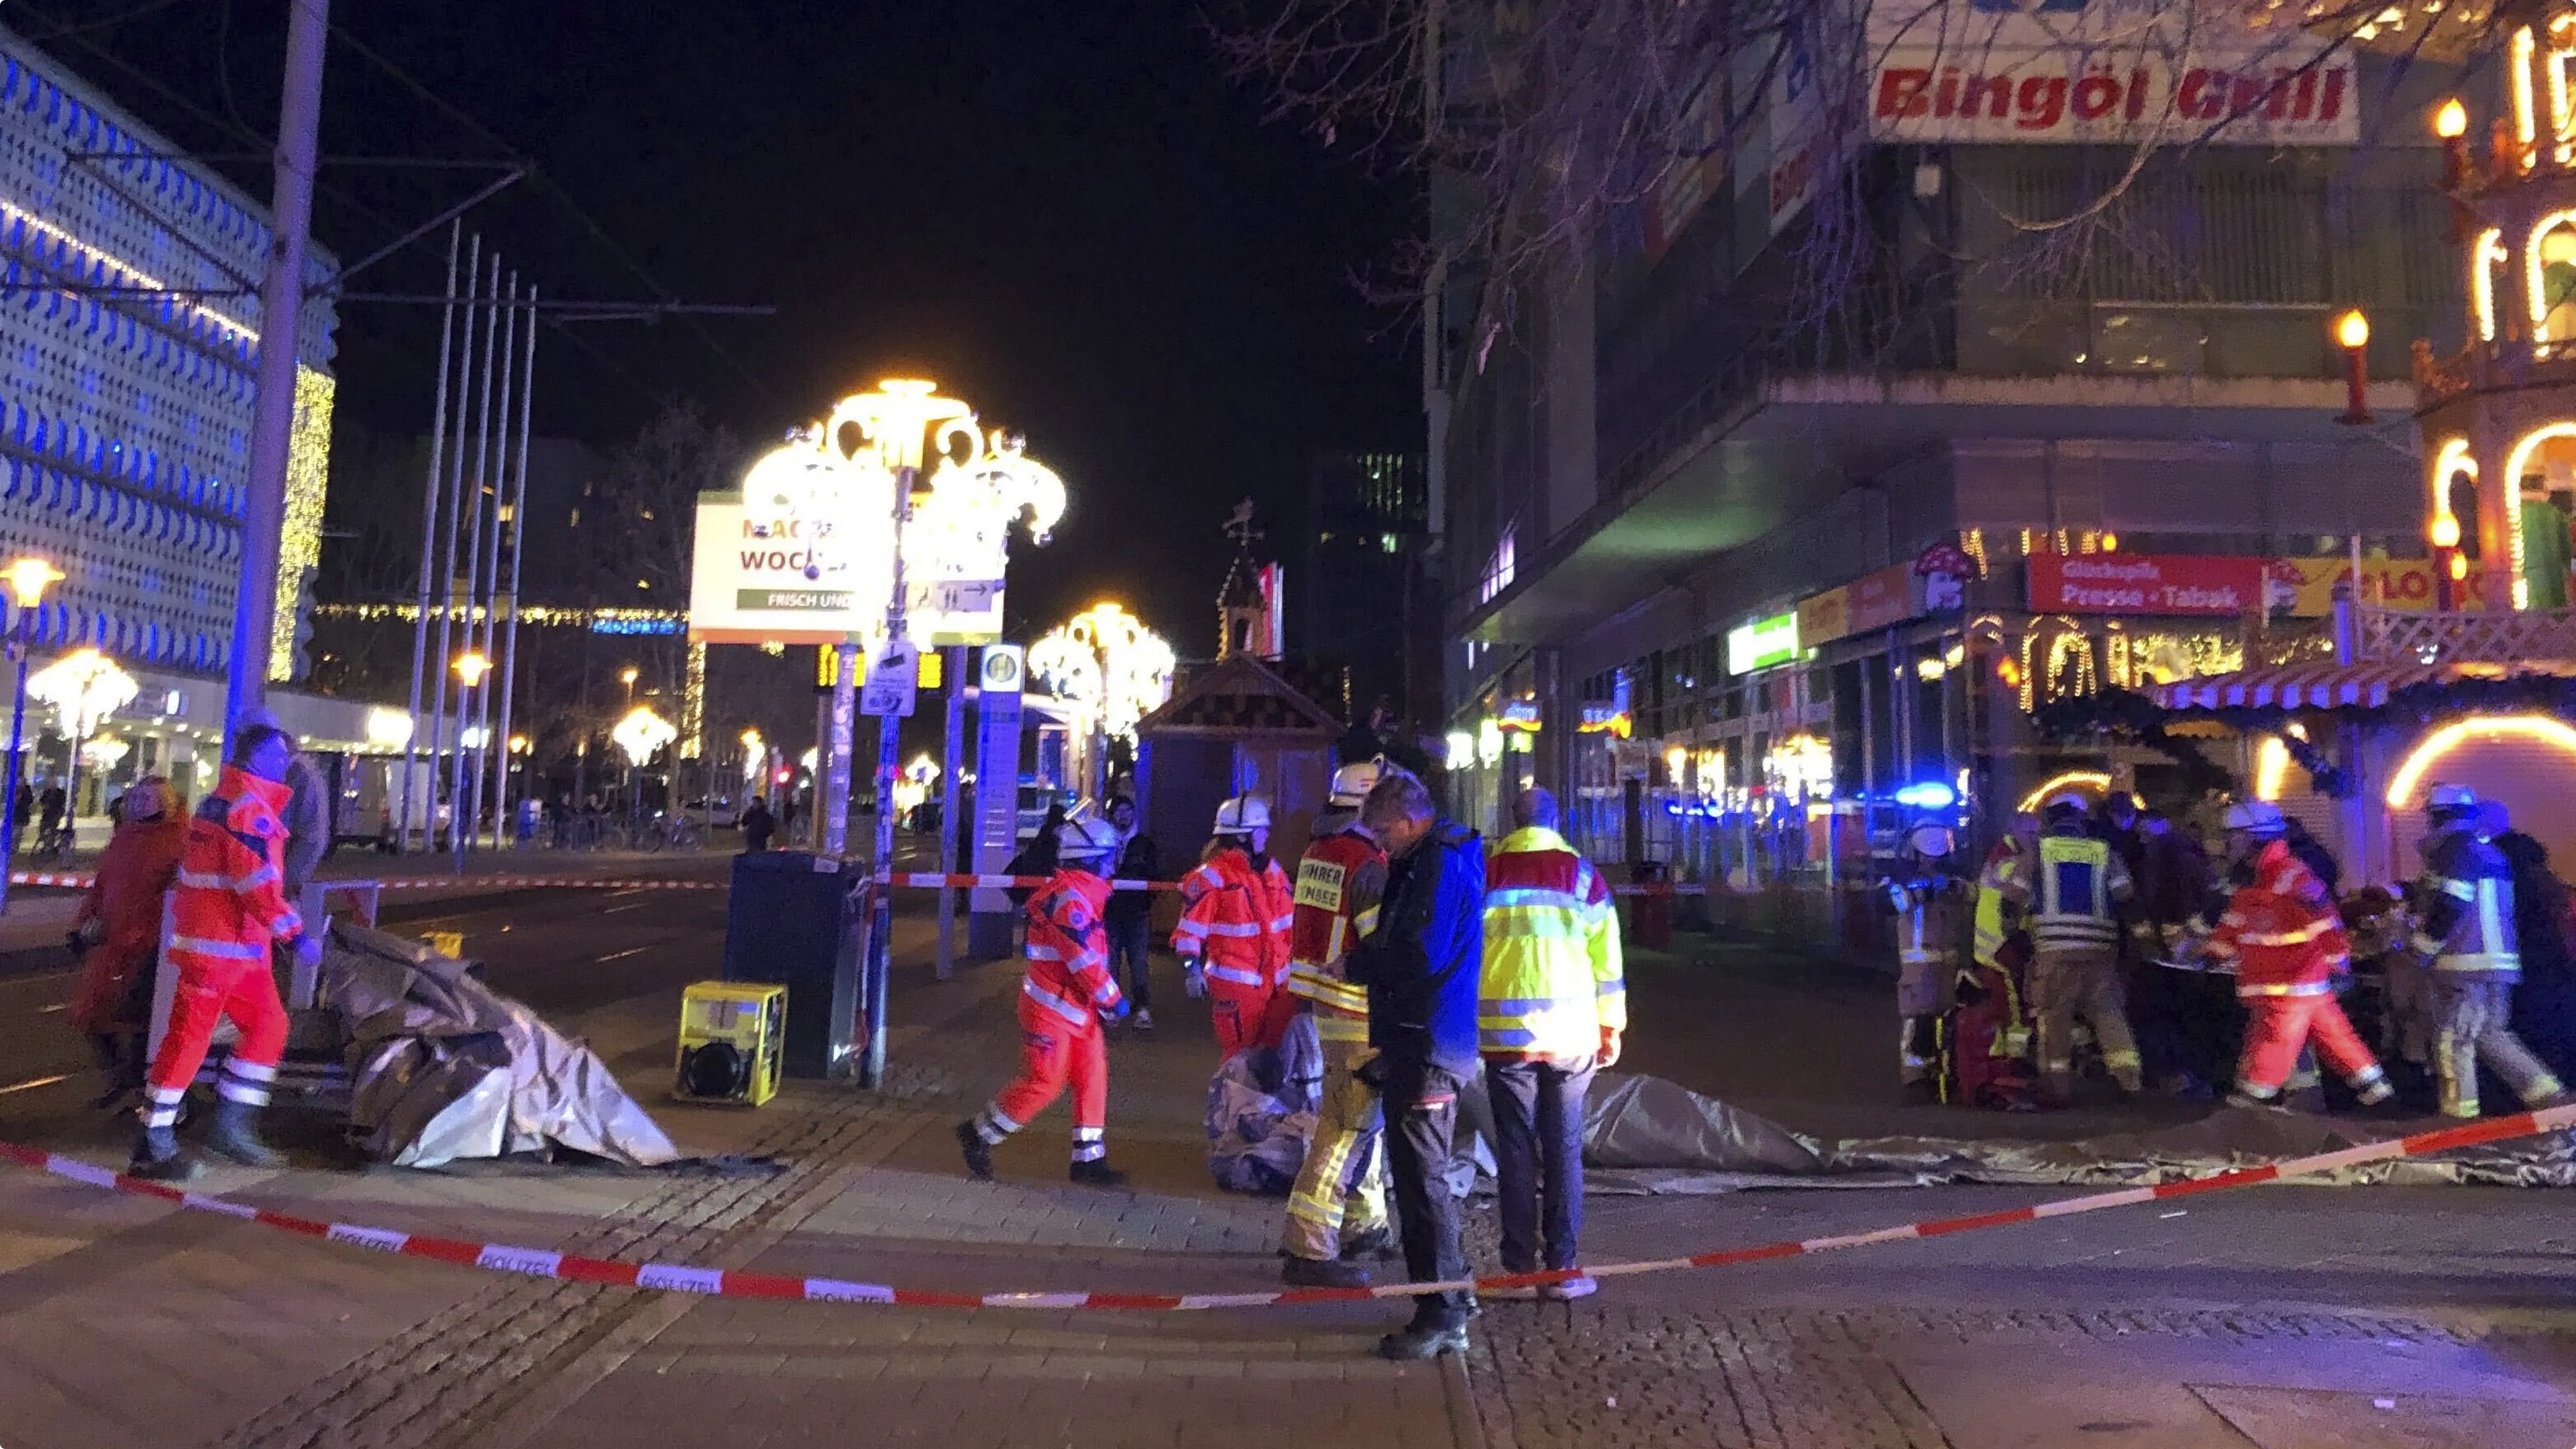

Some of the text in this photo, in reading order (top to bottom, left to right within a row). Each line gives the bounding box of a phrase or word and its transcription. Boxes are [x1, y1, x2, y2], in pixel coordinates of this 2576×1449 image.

[1876, 64, 2347, 131] Bingöl Grill
[768, 594, 816, 607] FRISCH
